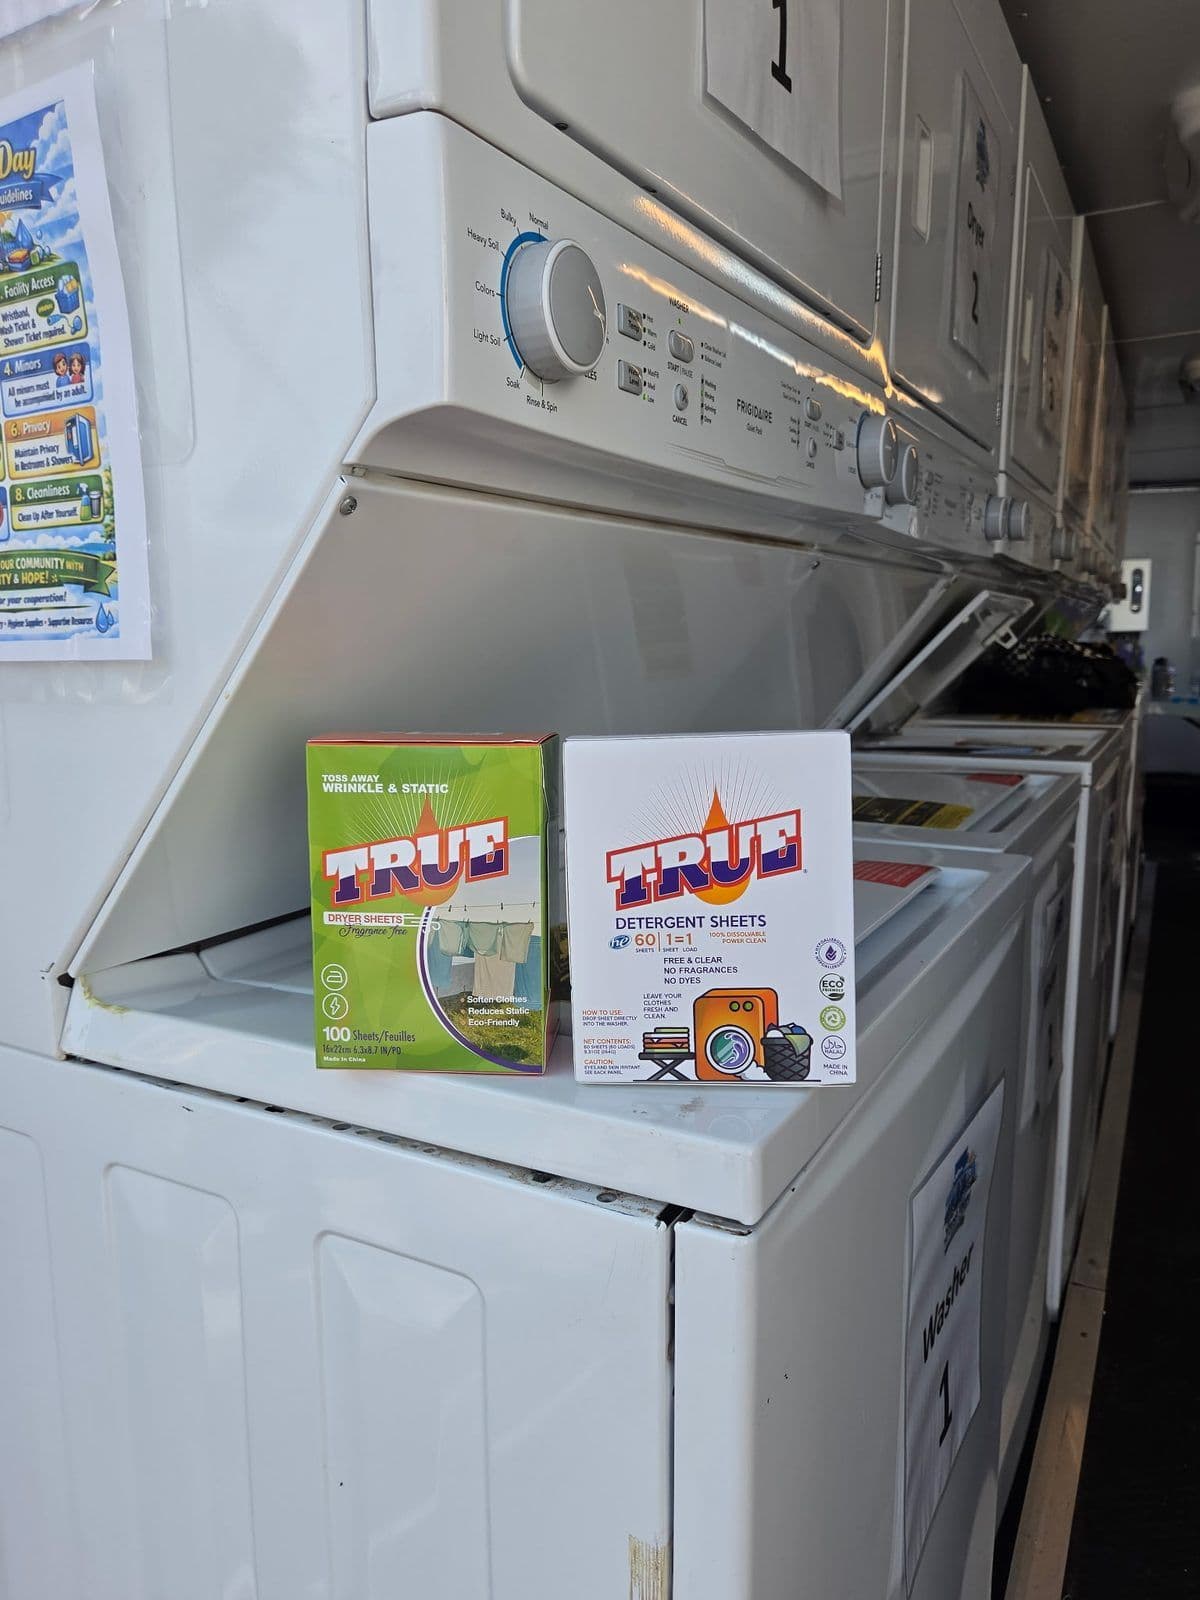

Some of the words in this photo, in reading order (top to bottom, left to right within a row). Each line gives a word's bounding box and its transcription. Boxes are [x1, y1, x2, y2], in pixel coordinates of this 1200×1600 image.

[771, 0, 792, 93] 1
[0, 140, 36, 179] Day
[0, 188, 33, 205] uidelines
[500, 208, 517, 227] Bulky
[528, 212, 549, 230] Normal
[467, 228, 487, 249] Heavy
[488, 235, 500, 250] Soil
[4, 282, 30, 299] Facility
[31, 275, 55, 291] Access
[475, 281, 495, 297] Colors
[669, 296, 689, 314] WASHER
[25, 332, 42, 343] Ticket
[473, 328, 489, 344] Light
[489, 334, 501, 347] Soil
[4, 361, 13, 376] 4.
[15, 359, 42, 374] Minors
[36, 380, 50, 391] must
[506, 377, 521, 389] Soak
[526, 394, 540, 409] Rinse
[541, 396, 547, 409] &
[546, 398, 558, 412] Spin
[736, 398, 772, 424] FRIGIDAIRE
[23, 420, 51, 435] Privacy
[672, 414, 688, 426] CANCEL
[39, 444, 59, 454] Privacy
[51, 455, 74, 466] Showers
[15, 488, 25, 501] 8.
[27, 484, 71, 500] Cleanliness
[18, 512, 32, 522] Clean
[33, 511, 39, 522] Up
[41, 510, 54, 519] After
[15, 557, 65, 570] COMMUNITY
[65, 561, 84, 572] WITH
[13, 573, 19, 584] &
[21, 570, 49, 585] HOPE!
[23, 591, 67, 606] cooperation!
[321, 774, 348, 783] TOSS
[351, 774, 380, 783] AWAY
[322, 783, 384, 793] WRINKLE
[388, 783, 397, 793] &
[401, 783, 449, 793] STATIC
[322, 816, 509, 907] TRUE
[606, 808, 802, 911] TRUE
[328, 914, 361, 923] DRYER
[363, 914, 403, 924] SHEETS
[615, 916, 705, 930] DETERGENT
[709, 914, 767, 928] SHEETS
[338, 922, 388, 938] Fragrance
[610, 935, 631, 949] he
[634, 933, 656, 946] 60
[666, 933, 693, 945] 1=1
[679, 966, 738, 974] FRAGRANCES
[822, 980, 844, 988] ECO
[467, 995, 495, 1003] Soften
[495, 995, 528, 1003] Clothes
[468, 1007, 504, 1015] Reduces
[505, 1006, 530, 1015] Static
[468, 1018, 520, 1027] Eco-Friendly
[323, 1026, 351, 1041] 100
[352, 1029, 416, 1043] Sheets/Feuilles
[323, 1044, 351, 1054] 16x22cm
[923, 1242, 974, 1364] Washer
[939, 1360, 952, 1447] 1
